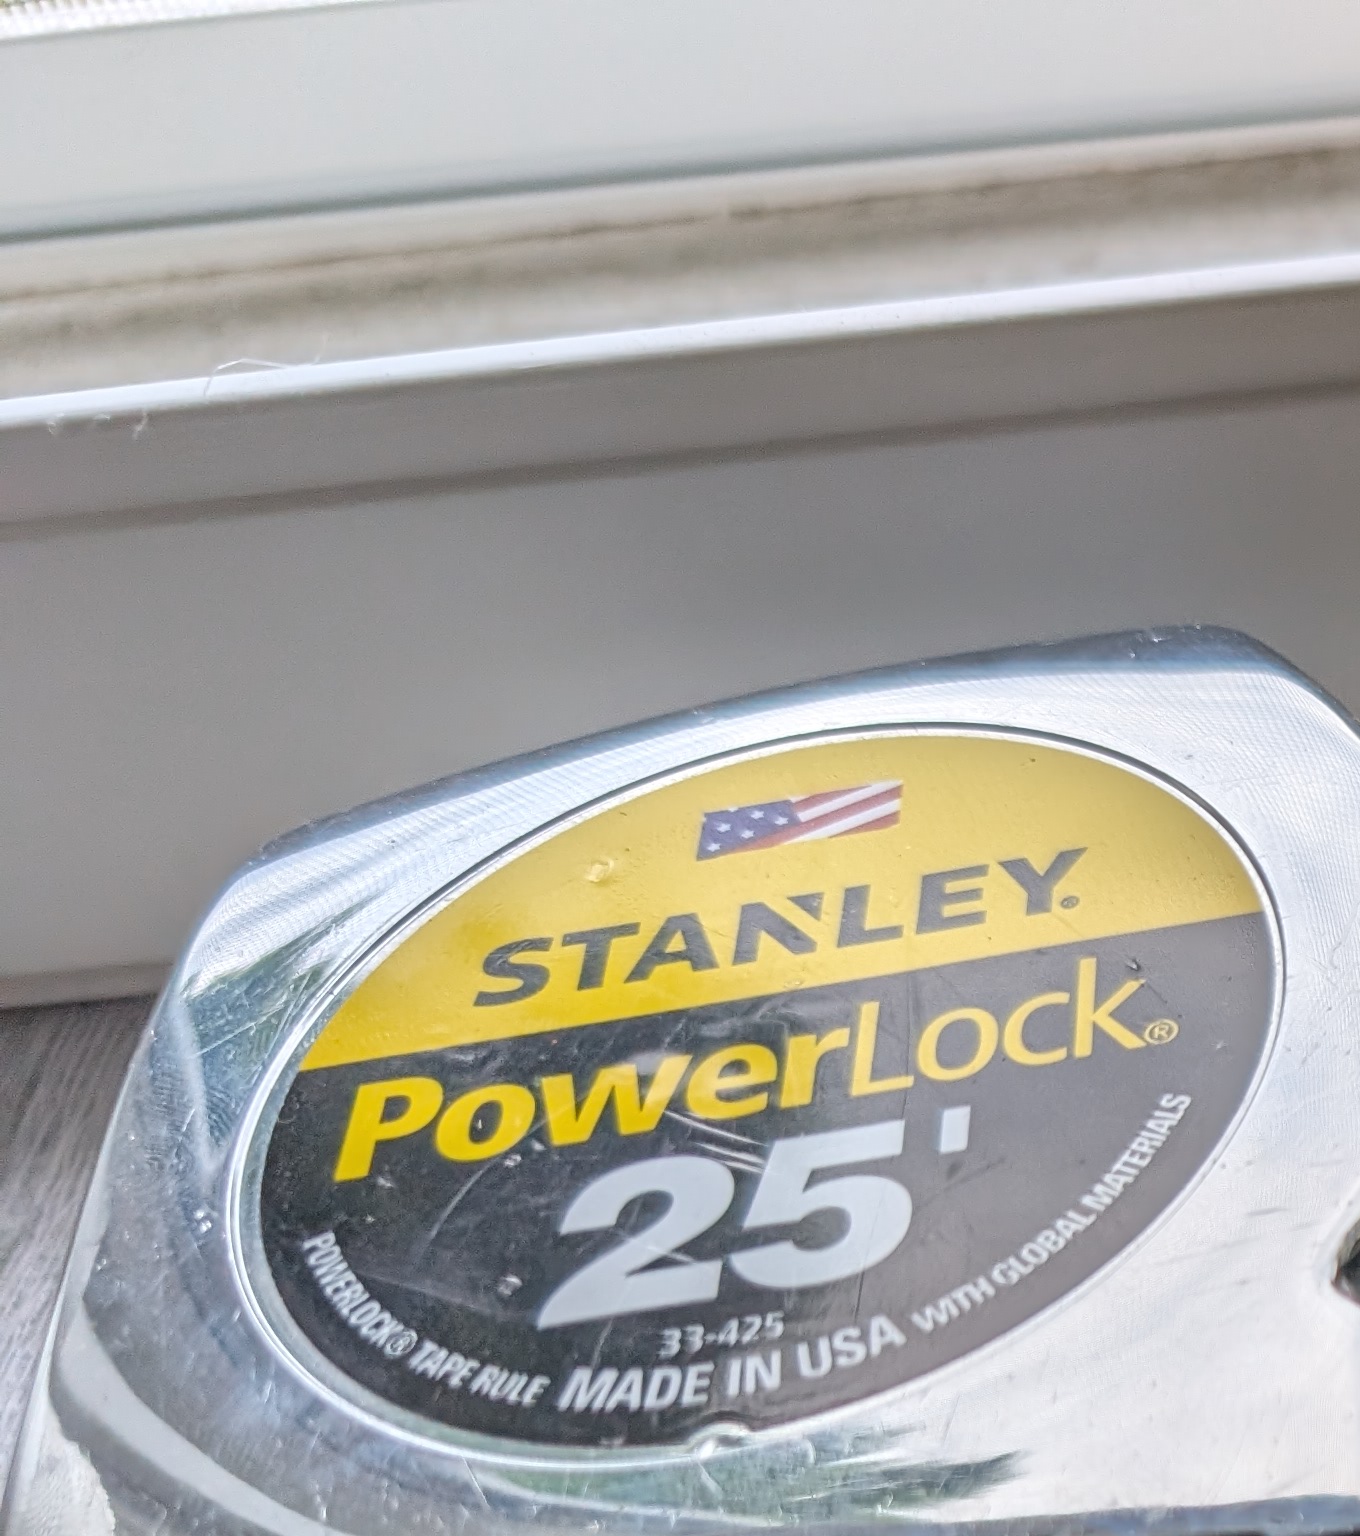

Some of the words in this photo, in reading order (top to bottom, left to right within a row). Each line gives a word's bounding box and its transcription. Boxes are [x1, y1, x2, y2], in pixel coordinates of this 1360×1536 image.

[911, 1275, 996, 1333] WITH
[992, 1208, 1097, 1286] GLOBAL
[1081, 1093, 1192, 1211] MATERIALS
[408, 1339, 480, 1388] TAPE
[469, 1363, 550, 1406] RULE
[558, 1361, 715, 1412] MADE
[727, 1350, 782, 1397] IN
[796, 1314, 906, 1377] USA
[657, 1310, 784, 1358] 33-425
